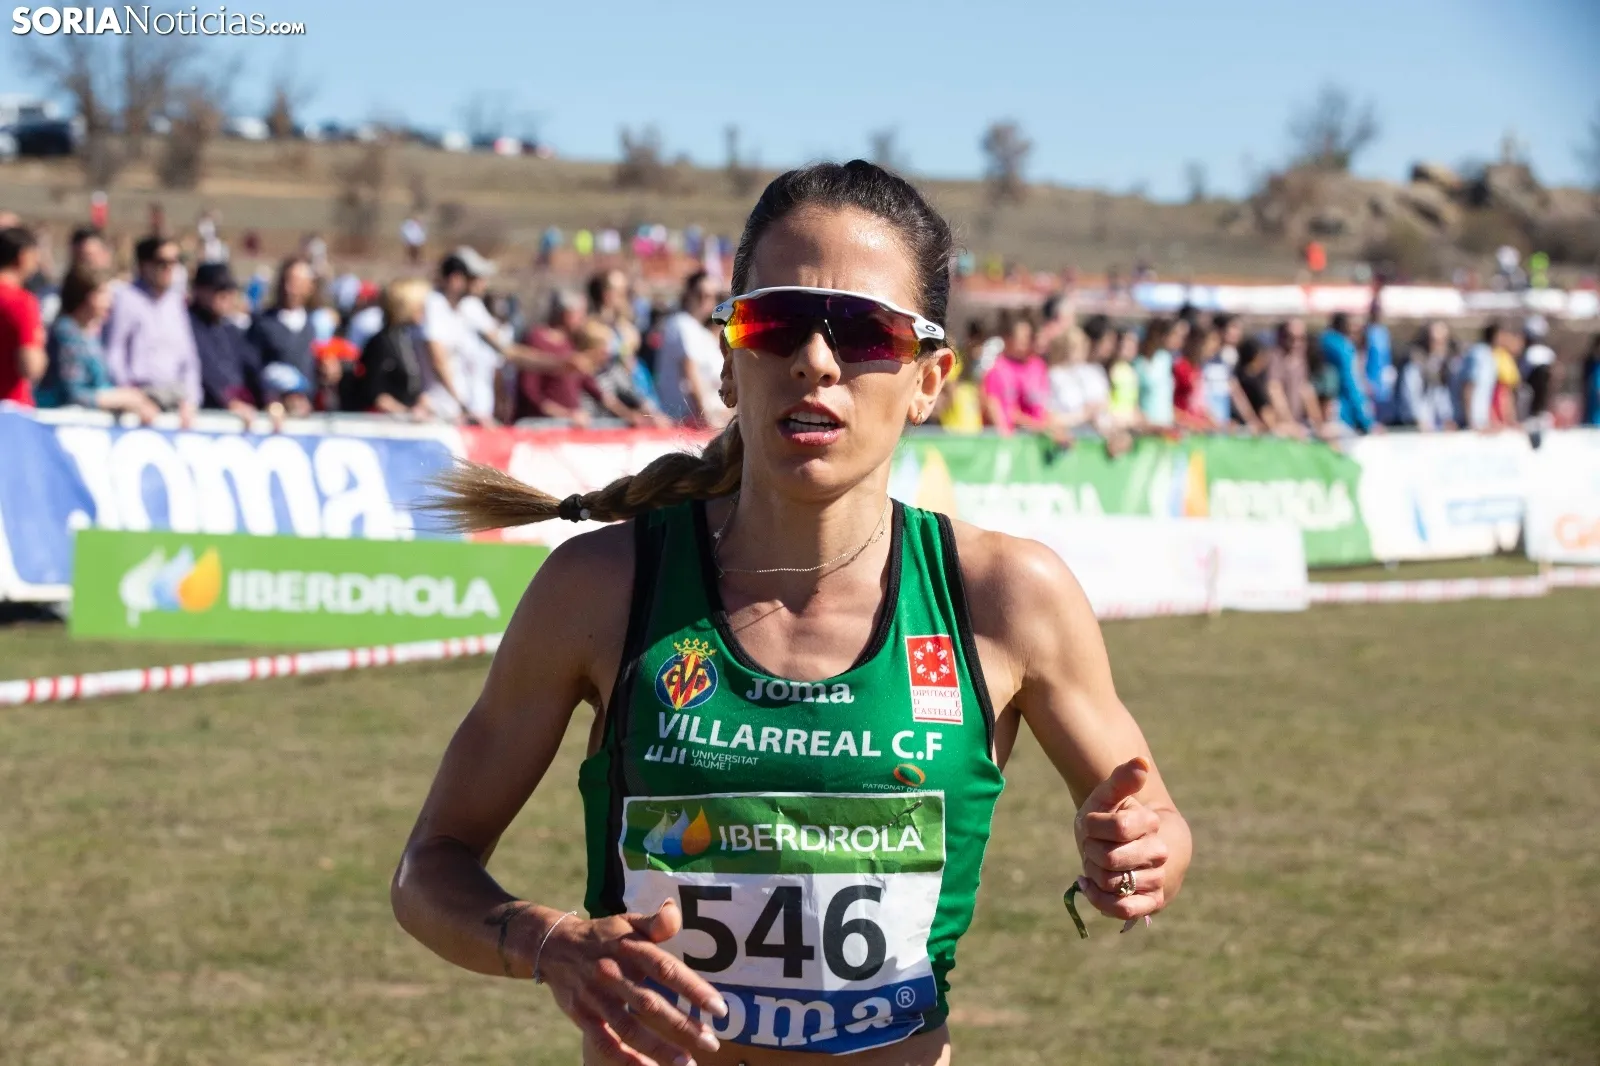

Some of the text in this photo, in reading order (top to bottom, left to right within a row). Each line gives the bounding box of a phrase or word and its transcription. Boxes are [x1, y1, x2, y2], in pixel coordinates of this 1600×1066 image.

[228, 569, 499, 618] IBERDROLA
[745, 678, 855, 704] Joma
[658, 711, 943, 760] VILLARREAL C.F
[690, 758, 726, 770] JAUME
[691, 749, 759, 766] UNIVERSITAT
[862, 783, 906, 791] PATRONAT
[719, 822, 925, 853] IBERDROLA
[677, 884, 887, 981] 546
[678, 990, 893, 1047] oma
